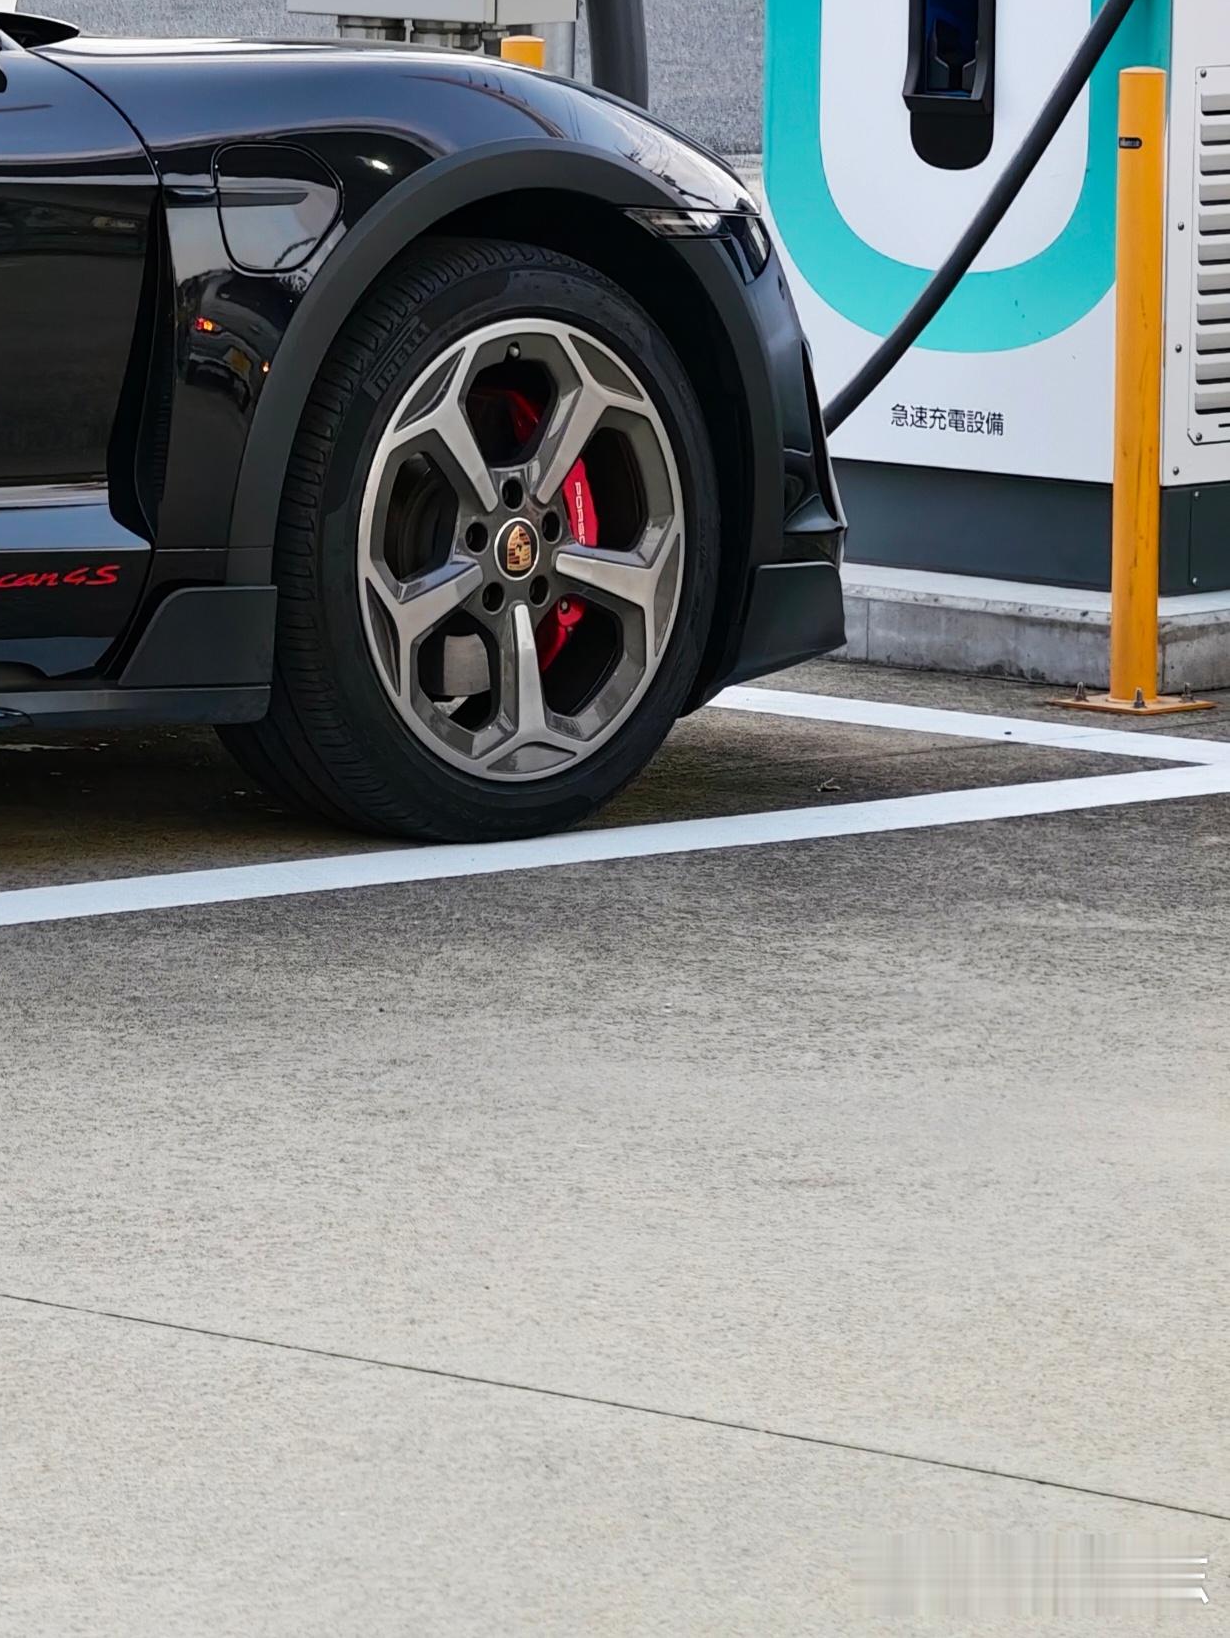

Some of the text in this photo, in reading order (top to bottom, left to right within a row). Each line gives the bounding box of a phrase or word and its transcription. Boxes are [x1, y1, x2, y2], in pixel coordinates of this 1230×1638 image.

[890, 403, 1005, 437] 急速充電設備
[63, 564, 121, 586] 4S
